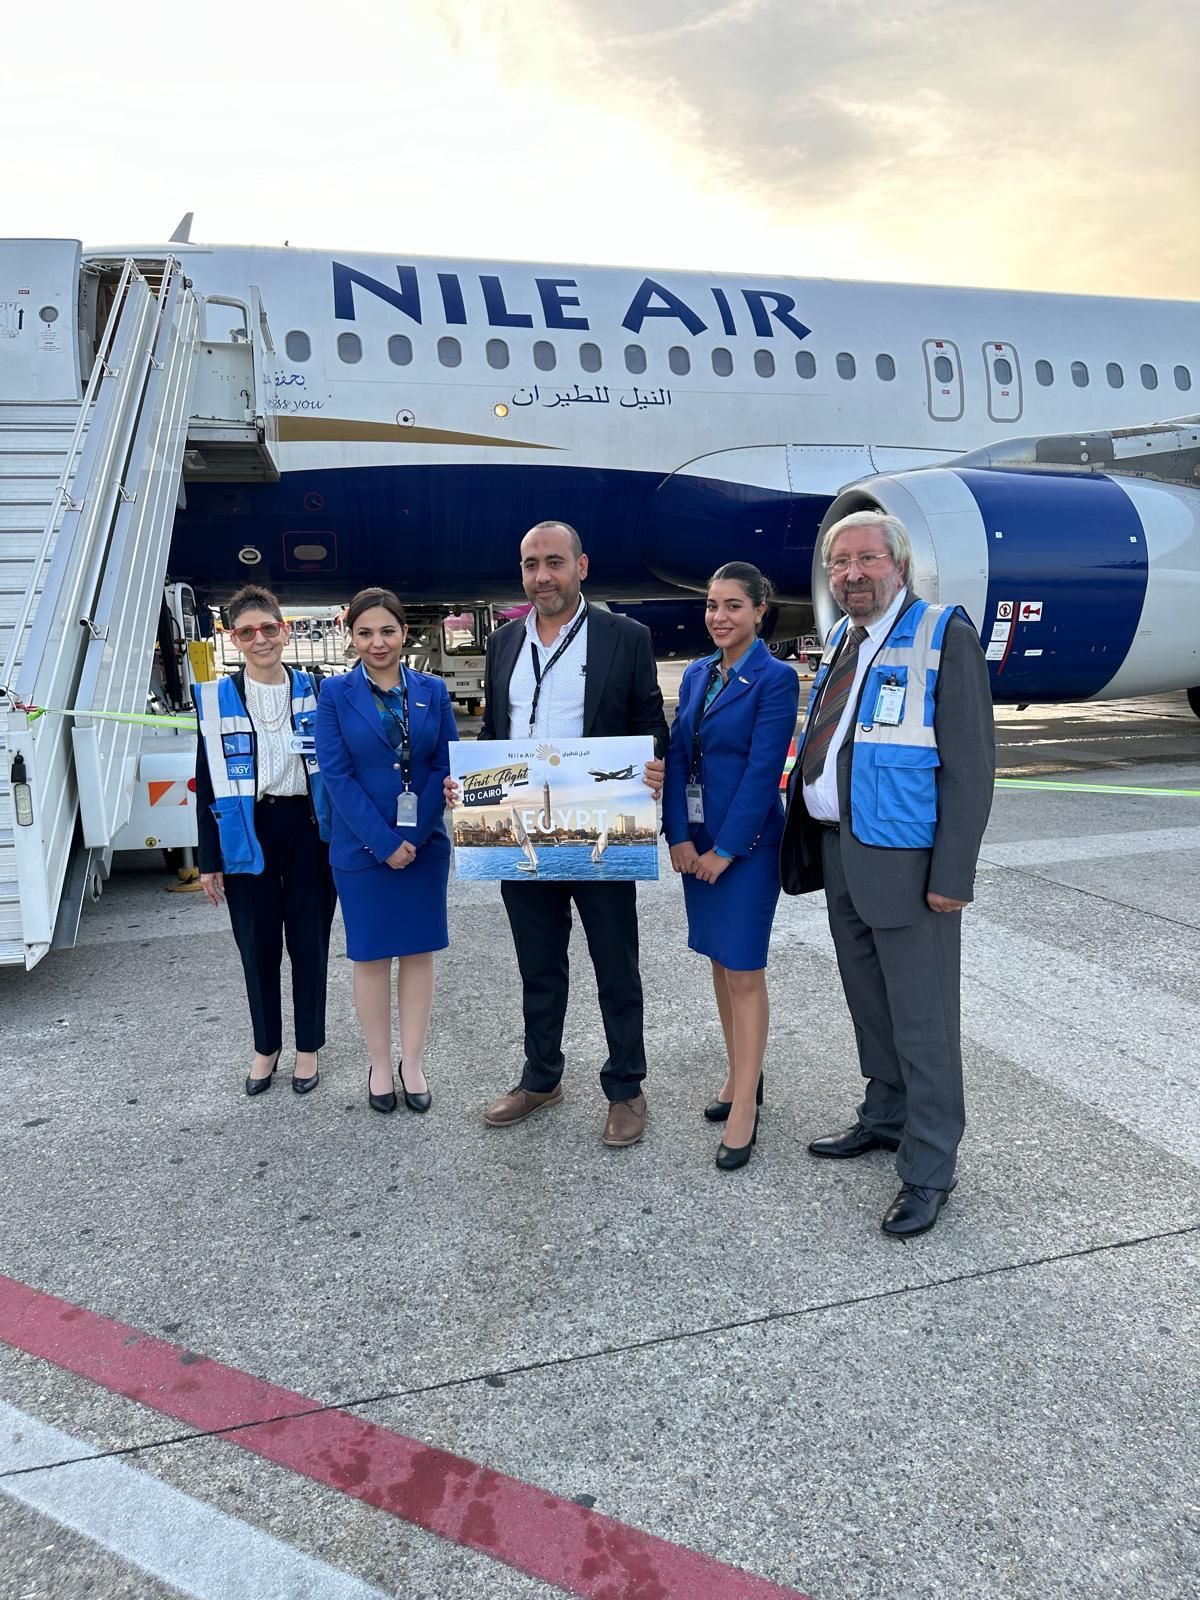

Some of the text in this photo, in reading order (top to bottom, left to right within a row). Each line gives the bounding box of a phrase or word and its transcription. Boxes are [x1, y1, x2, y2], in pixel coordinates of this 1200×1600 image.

[332, 261, 812, 341] NILE AIR
[291, 400, 324, 412] you
[512, 384, 672, 409] النيل للطيران
[463, 767, 531, 790] First Flight
[465, 788, 501, 802] TO CAIRO
[522, 808, 607, 834] EGYPT
